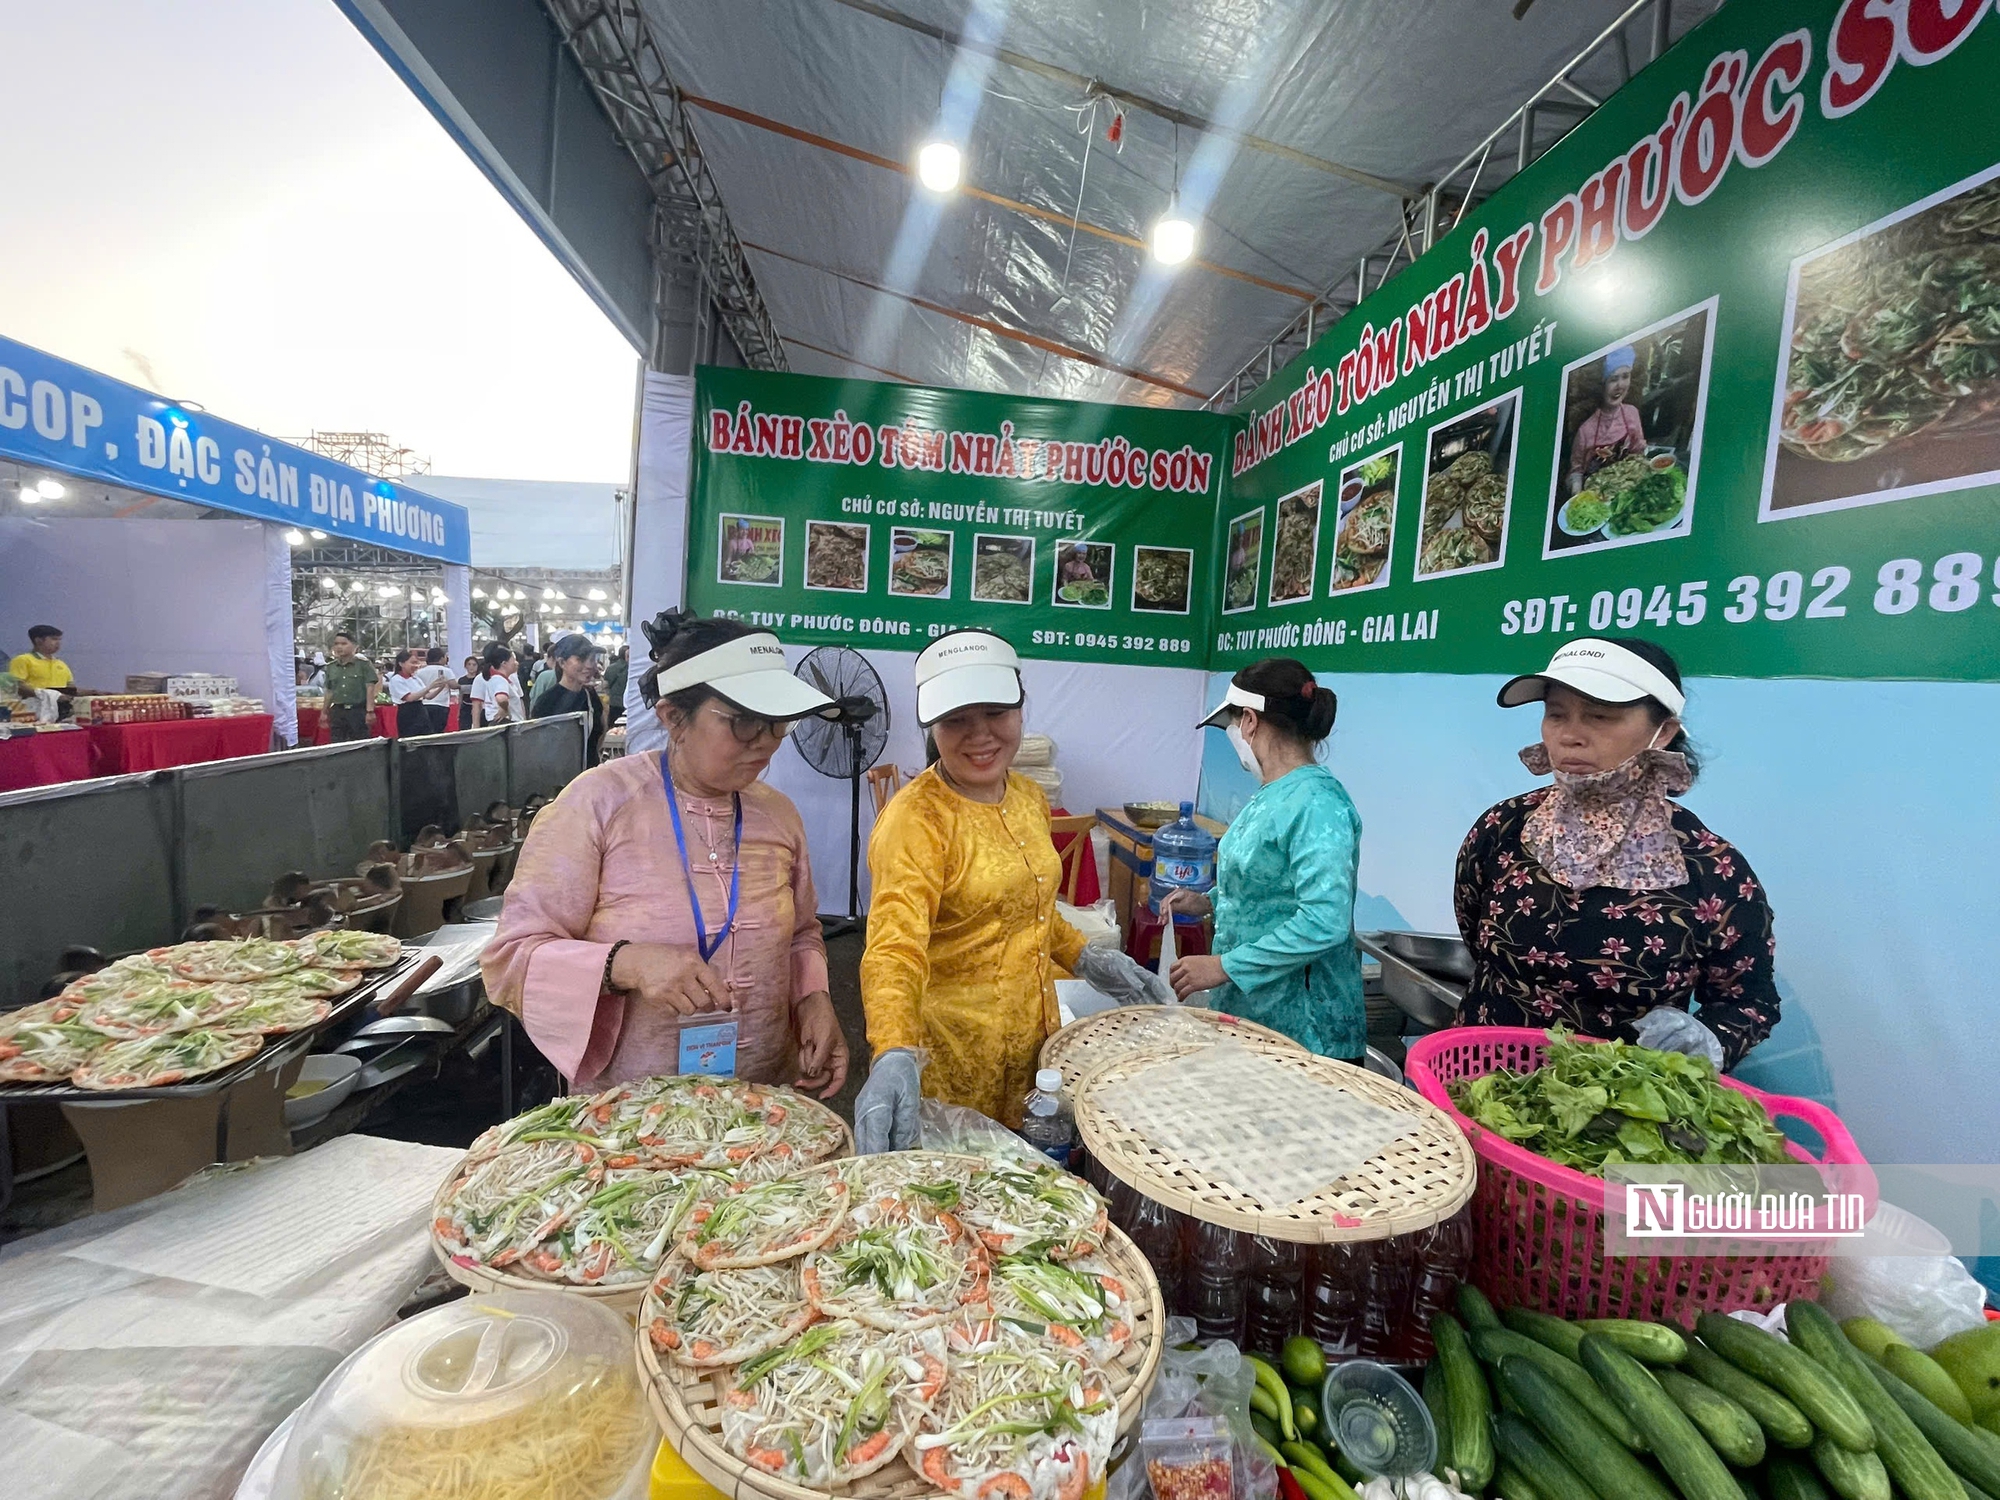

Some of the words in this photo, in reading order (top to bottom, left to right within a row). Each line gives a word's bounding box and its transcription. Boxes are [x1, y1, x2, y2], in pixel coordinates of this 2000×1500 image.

[1232, 400, 1286, 478] BÁNH
[1285, 366, 1334, 447] XÈO
[1337, 317, 1402, 416] TÔM
[1402, 222, 1534, 377] NHẢY
[1535, 28, 1812, 296] PHƯỚC
[1329, 431, 1348, 463] CHỦ
[1350, 427, 1366, 453] CƠ
[1366, 413, 1385, 445] SỞ:
[1387, 376, 1450, 435] NGUYỄN
[1455, 361, 1485, 397] THỊ
[1490, 318, 1557, 384] TUYẾT
[135, 415, 221, 487] ĐẶC
[235, 444, 299, 507] SẢN
[309, 473, 356, 527] ĐỊA
[363, 493, 445, 547] PHƯƠNG
[709, 400, 805, 460] BÁNH
[806, 409, 875, 465] XÈO
[878, 416, 947, 472] TÔM
[1045, 436, 1148, 489] PHƯỚC
[1150, 445, 1212, 494] SƠN
[841, 495, 871, 514] CHỦ
[876, 499, 897, 516] CƠ
[900, 498, 924, 518] SỞ:
[929, 500, 999, 524] NGUYỄN
[1034, 509, 1085, 531] TUYẾT
[751, 611, 785, 627] TUY
[790, 612, 854, 632] PHƯỚC
[860, 617, 910, 636] ĐÔNG
[1217, 633, 1234, 651] ĐC:
[1235, 629, 1257, 650] TUY
[1257, 621, 1300, 649] PHƯỚC
[1303, 618, 1346, 647] ĐÔNG
[1362, 614, 1395, 643] GIA
[1401, 609, 1439, 641] LAI
[1500, 594, 1576, 636] SĐT:
[1588, 581, 1708, 630] 0945
[1724, 566, 1852, 624] 392
[1873, 552, 2000, 615] 88
[1032, 630, 1070, 646] SĐT:
[1075, 633, 1118, 648] 0945
[1123, 636, 1154, 651] 392
[1159, 638, 1191, 653] 889
